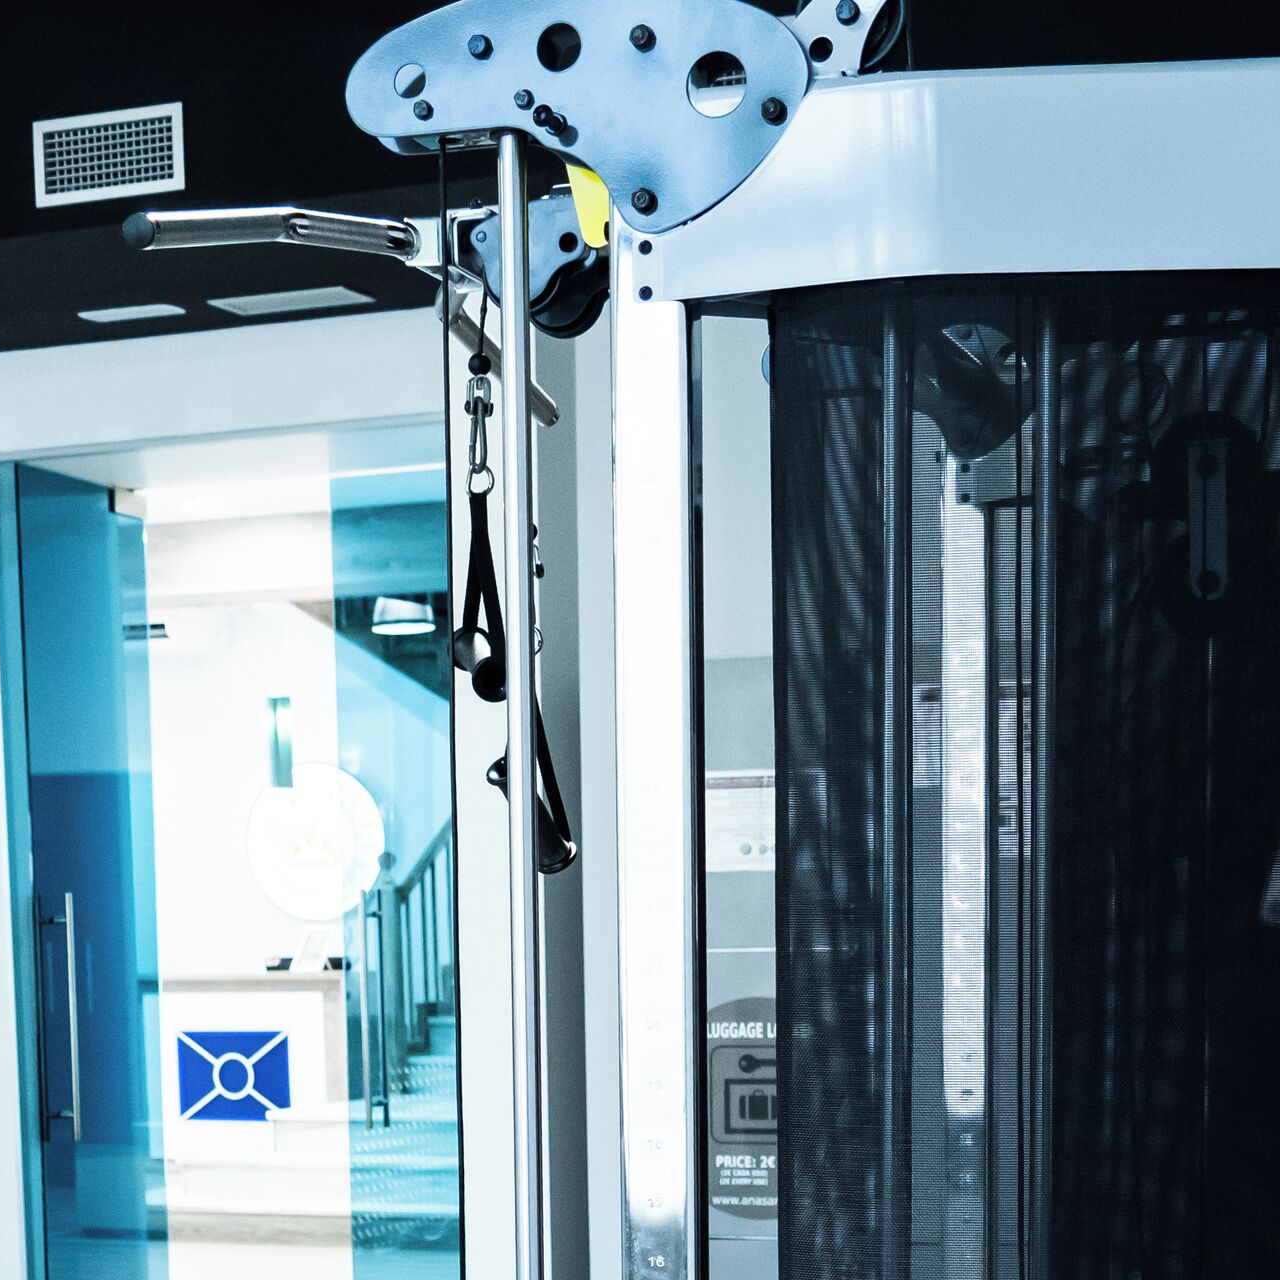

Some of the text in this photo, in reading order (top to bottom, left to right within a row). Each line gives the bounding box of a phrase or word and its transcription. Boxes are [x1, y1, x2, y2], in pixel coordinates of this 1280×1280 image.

[706, 1021, 764, 1039] LUGGAGE
[715, 1154, 757, 1169] PRICE:
[648, 1255, 665, 1267] 16
